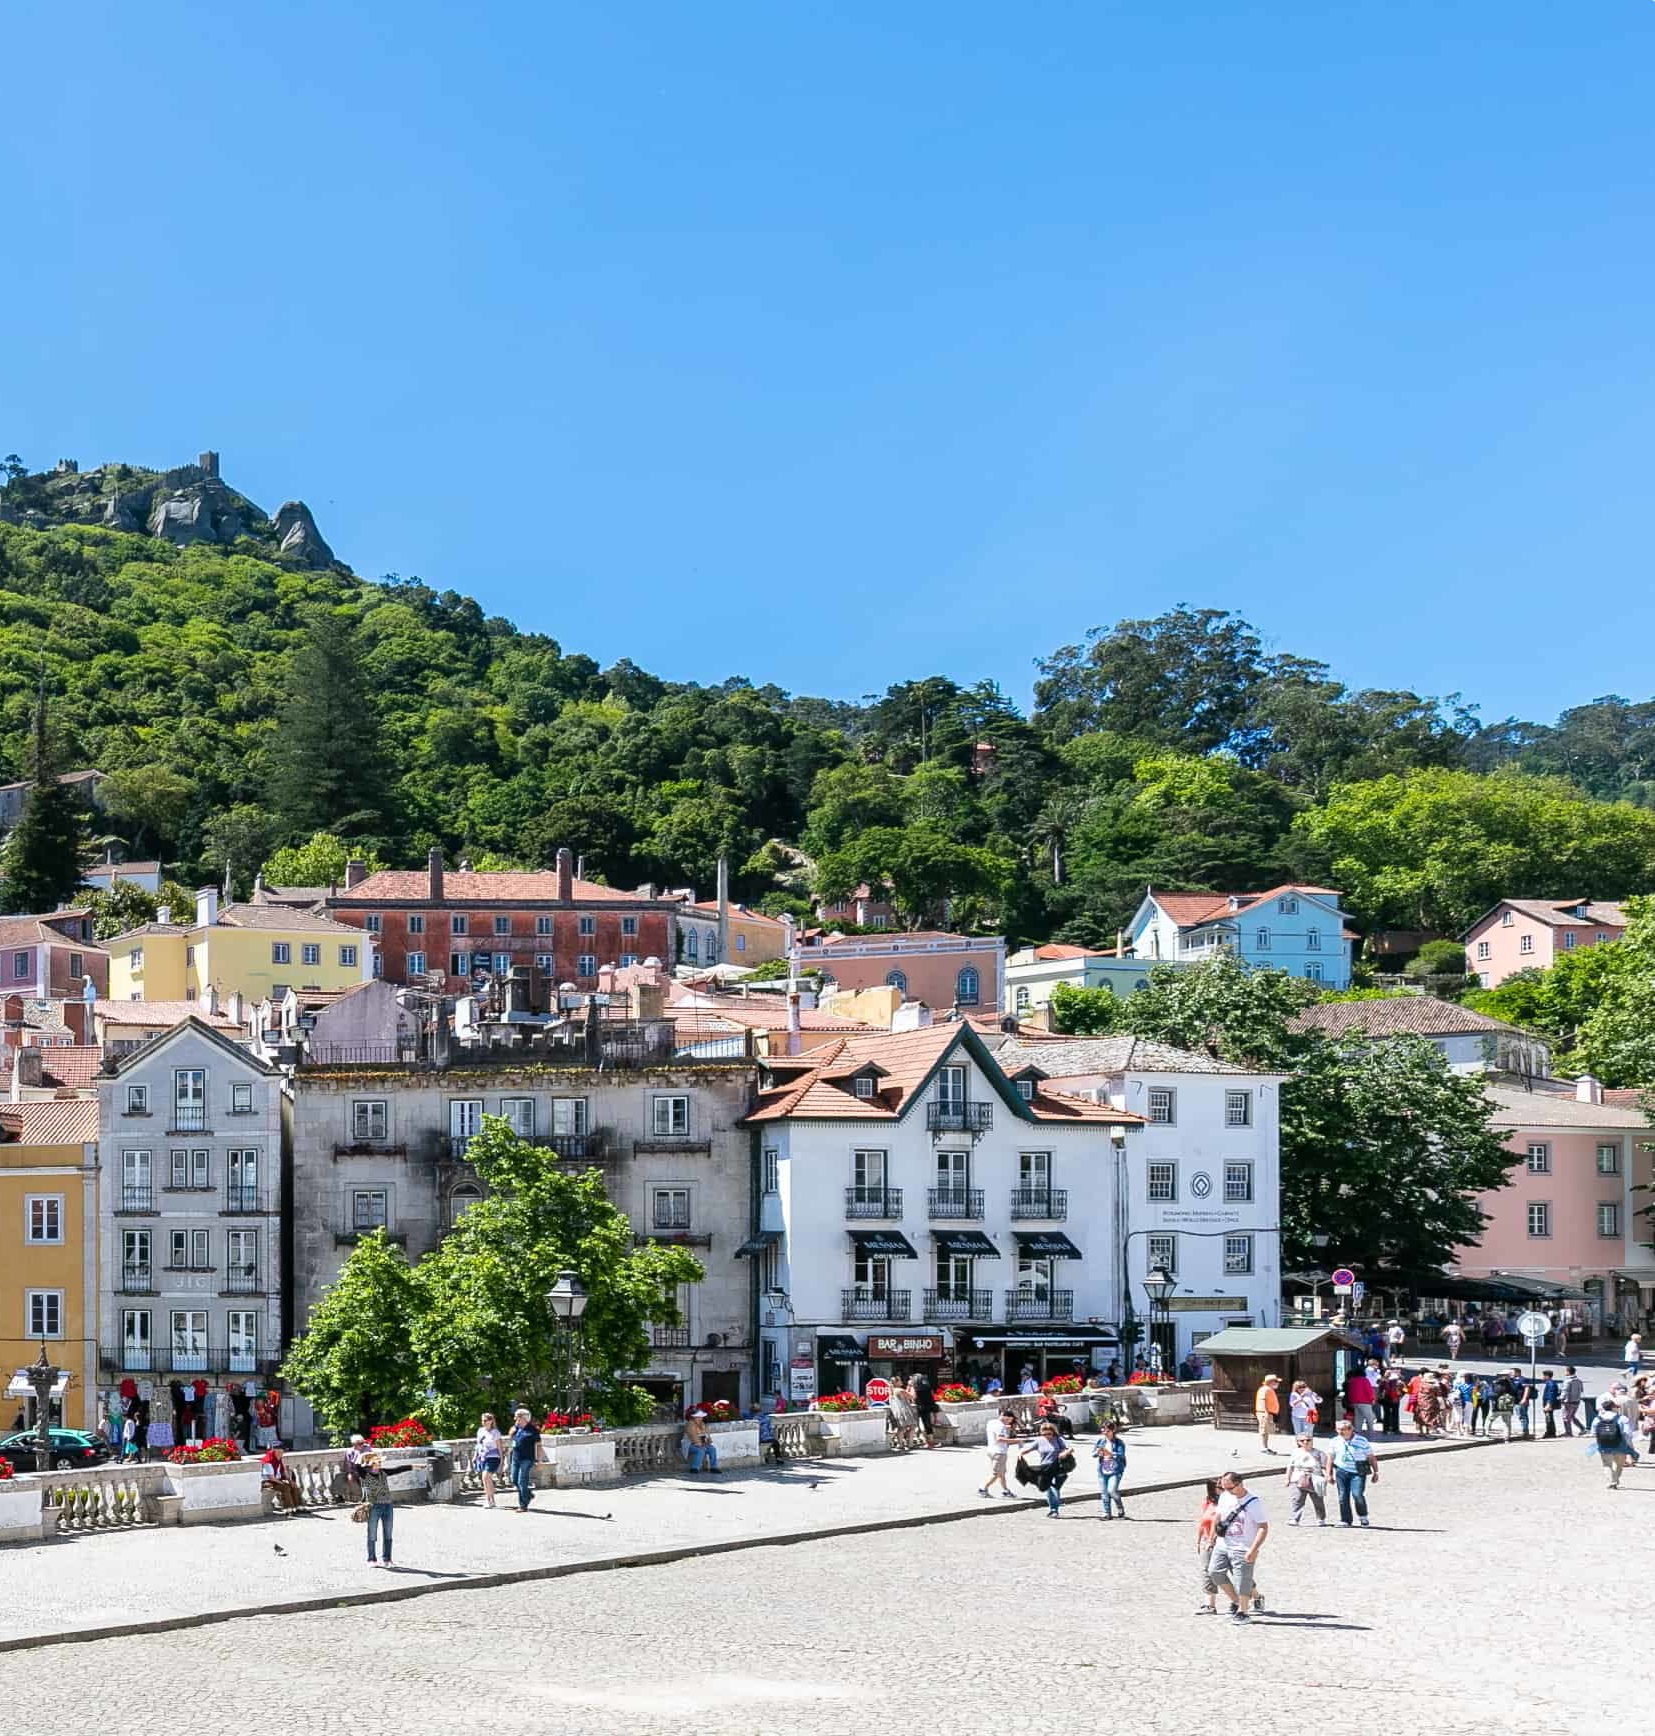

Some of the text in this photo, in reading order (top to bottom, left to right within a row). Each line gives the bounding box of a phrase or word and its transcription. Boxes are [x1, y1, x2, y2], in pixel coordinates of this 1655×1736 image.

[877, 1338, 933, 1350] BAR BINHO
[866, 1386, 890, 1396] STOP
